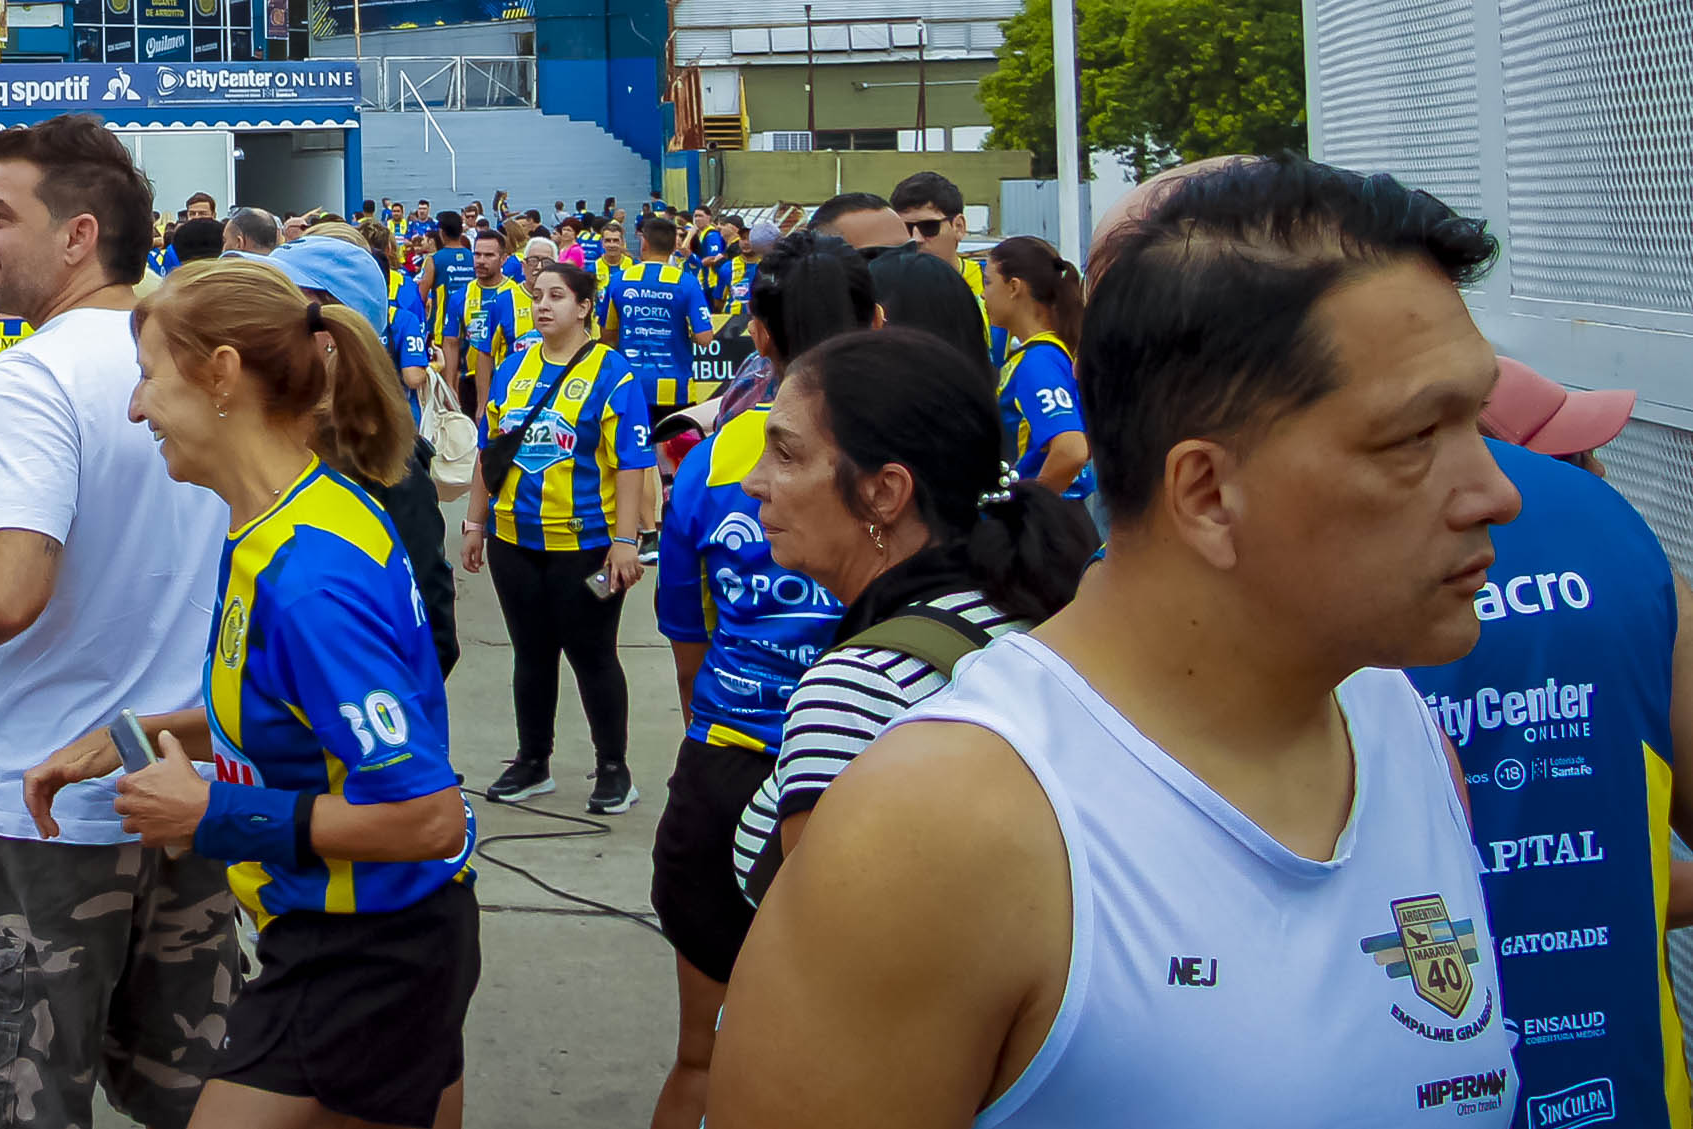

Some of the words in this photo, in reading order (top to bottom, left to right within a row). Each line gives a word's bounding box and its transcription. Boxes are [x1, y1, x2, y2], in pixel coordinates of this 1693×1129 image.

[145, 34, 186, 59] Quilmes
[11, 75, 89, 106] sportif
[275, 71, 354, 87] ONLINE
[640, 289, 673, 300] Macro
[634, 306, 671, 318] PORTA
[406, 336, 425, 353] 30
[1036, 386, 1073, 414] 30
[633, 425, 650, 447] 3
[1473, 571, 1591, 622] acro
[340, 689, 407, 756] 30
[1424, 678, 1593, 747] ityCenter
[1524, 722, 1591, 744] ONLINE
[1464, 773, 1490, 785] ÑOS
[1551, 767, 1579, 778] Santa
[1580, 764, 1593, 775] Fe
[1402, 905, 1444, 923] ARGENTINA
[1413, 943, 1457, 961] MARATÓN
[1500, 926, 1608, 956] GATORADE
[1167, 956, 1219, 987] NEJ
[1427, 958, 1463, 993] 40
[1391, 1003, 1454, 1043] EMPALME
[1523, 1011, 1606, 1036] ENSALUD
